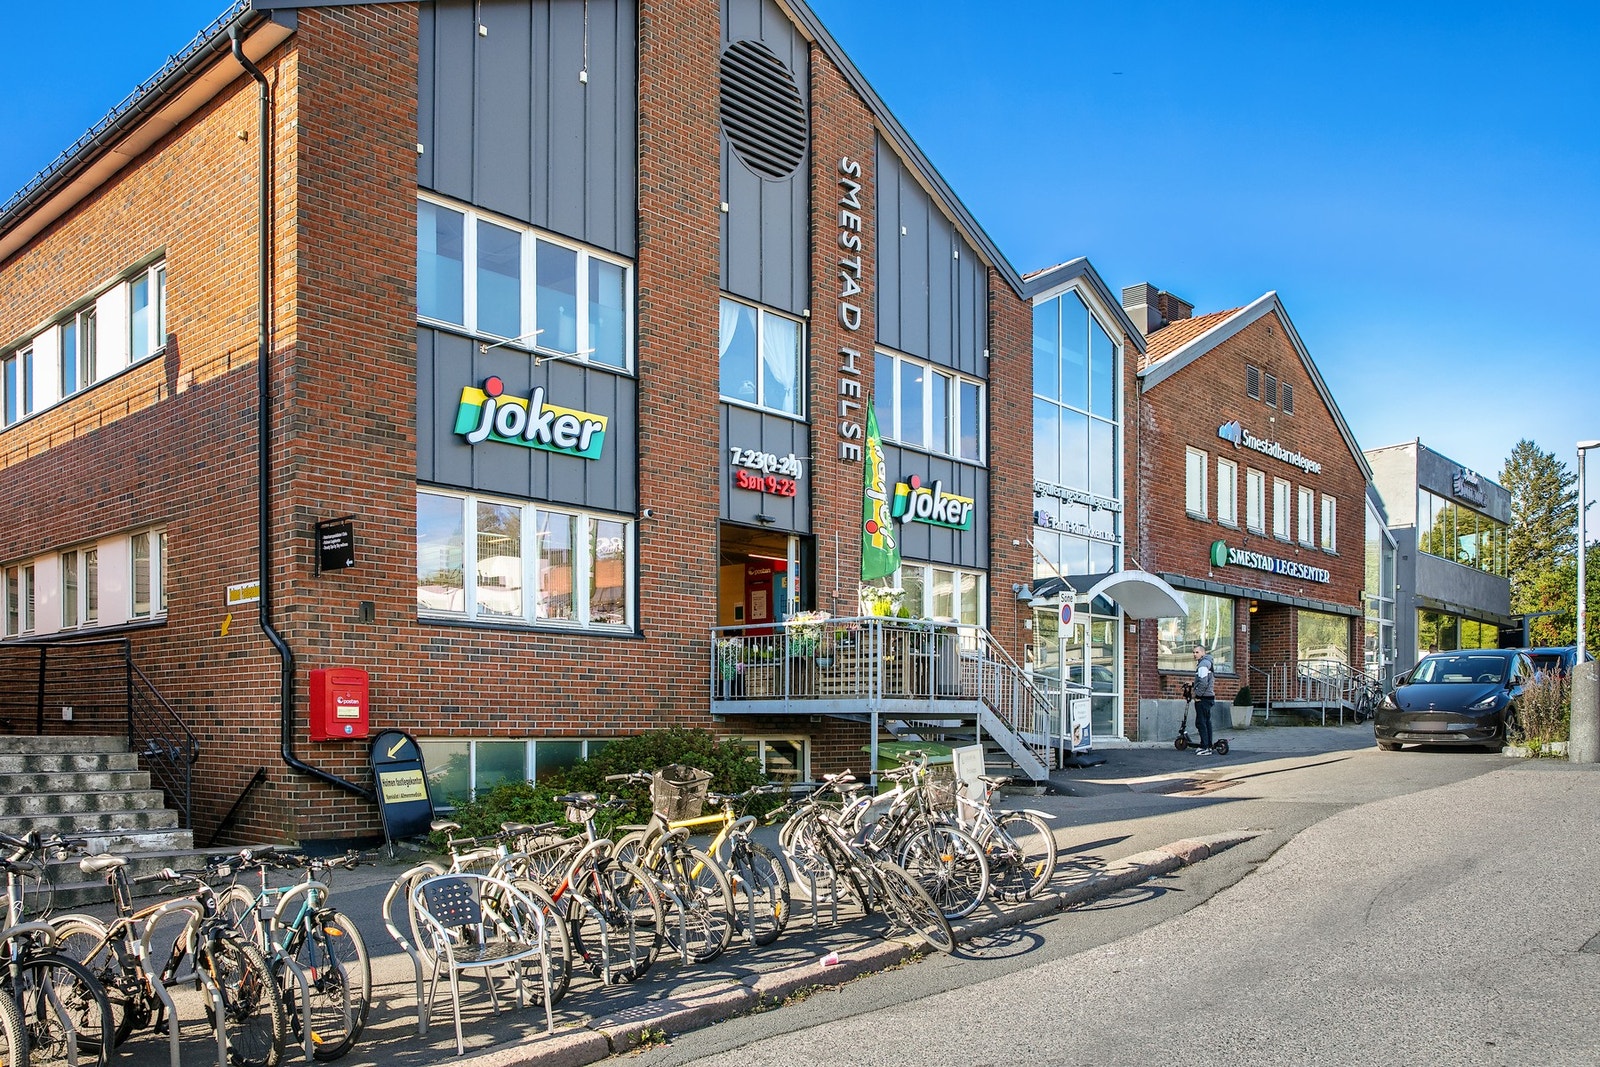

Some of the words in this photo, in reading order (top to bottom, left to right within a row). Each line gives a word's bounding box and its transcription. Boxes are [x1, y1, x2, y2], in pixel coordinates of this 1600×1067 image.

[837, 156, 862, 331] SMESTAD
[466, 375, 604, 452] joker
[837, 347, 862, 462] HELSE
[730, 446, 803, 480] 7-23(9-24)
[1242, 429, 1322, 475] Smestadbarnelegene
[736, 469, 765, 492] Søn
[765, 474, 797, 497] 9-23
[901, 474, 973, 525] joker
[1229, 547, 1274, 572] SMESTAD
[1276, 559, 1331, 584] LEGESENTER
[1060, 593, 1073, 603] Sone
